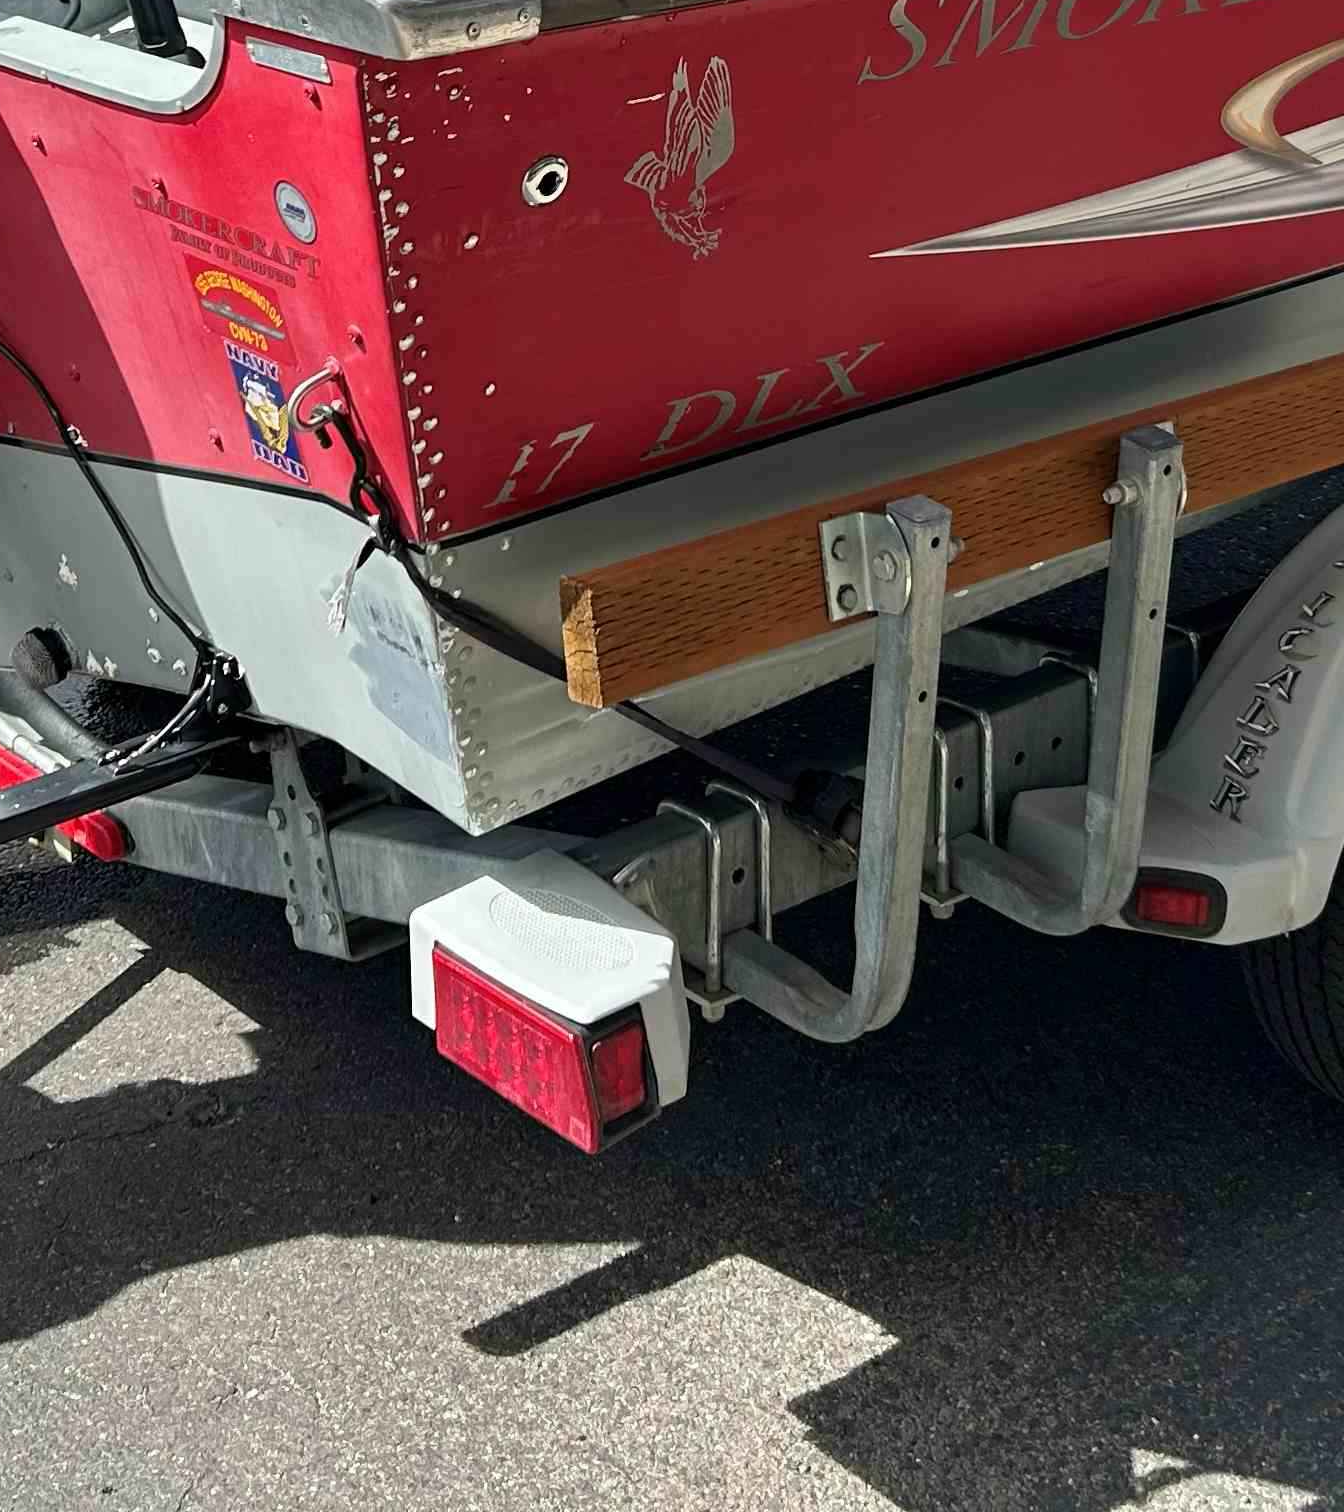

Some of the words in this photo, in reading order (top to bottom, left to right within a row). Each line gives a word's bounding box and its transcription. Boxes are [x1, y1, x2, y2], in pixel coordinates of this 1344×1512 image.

[131, 184, 322, 280] SMOKERCRAFT
[224, 339, 280, 381] NAVY
[252, 438, 310, 484] DAD
[482, 422, 596, 510] 17
[640, 341, 886, 462] DLX
